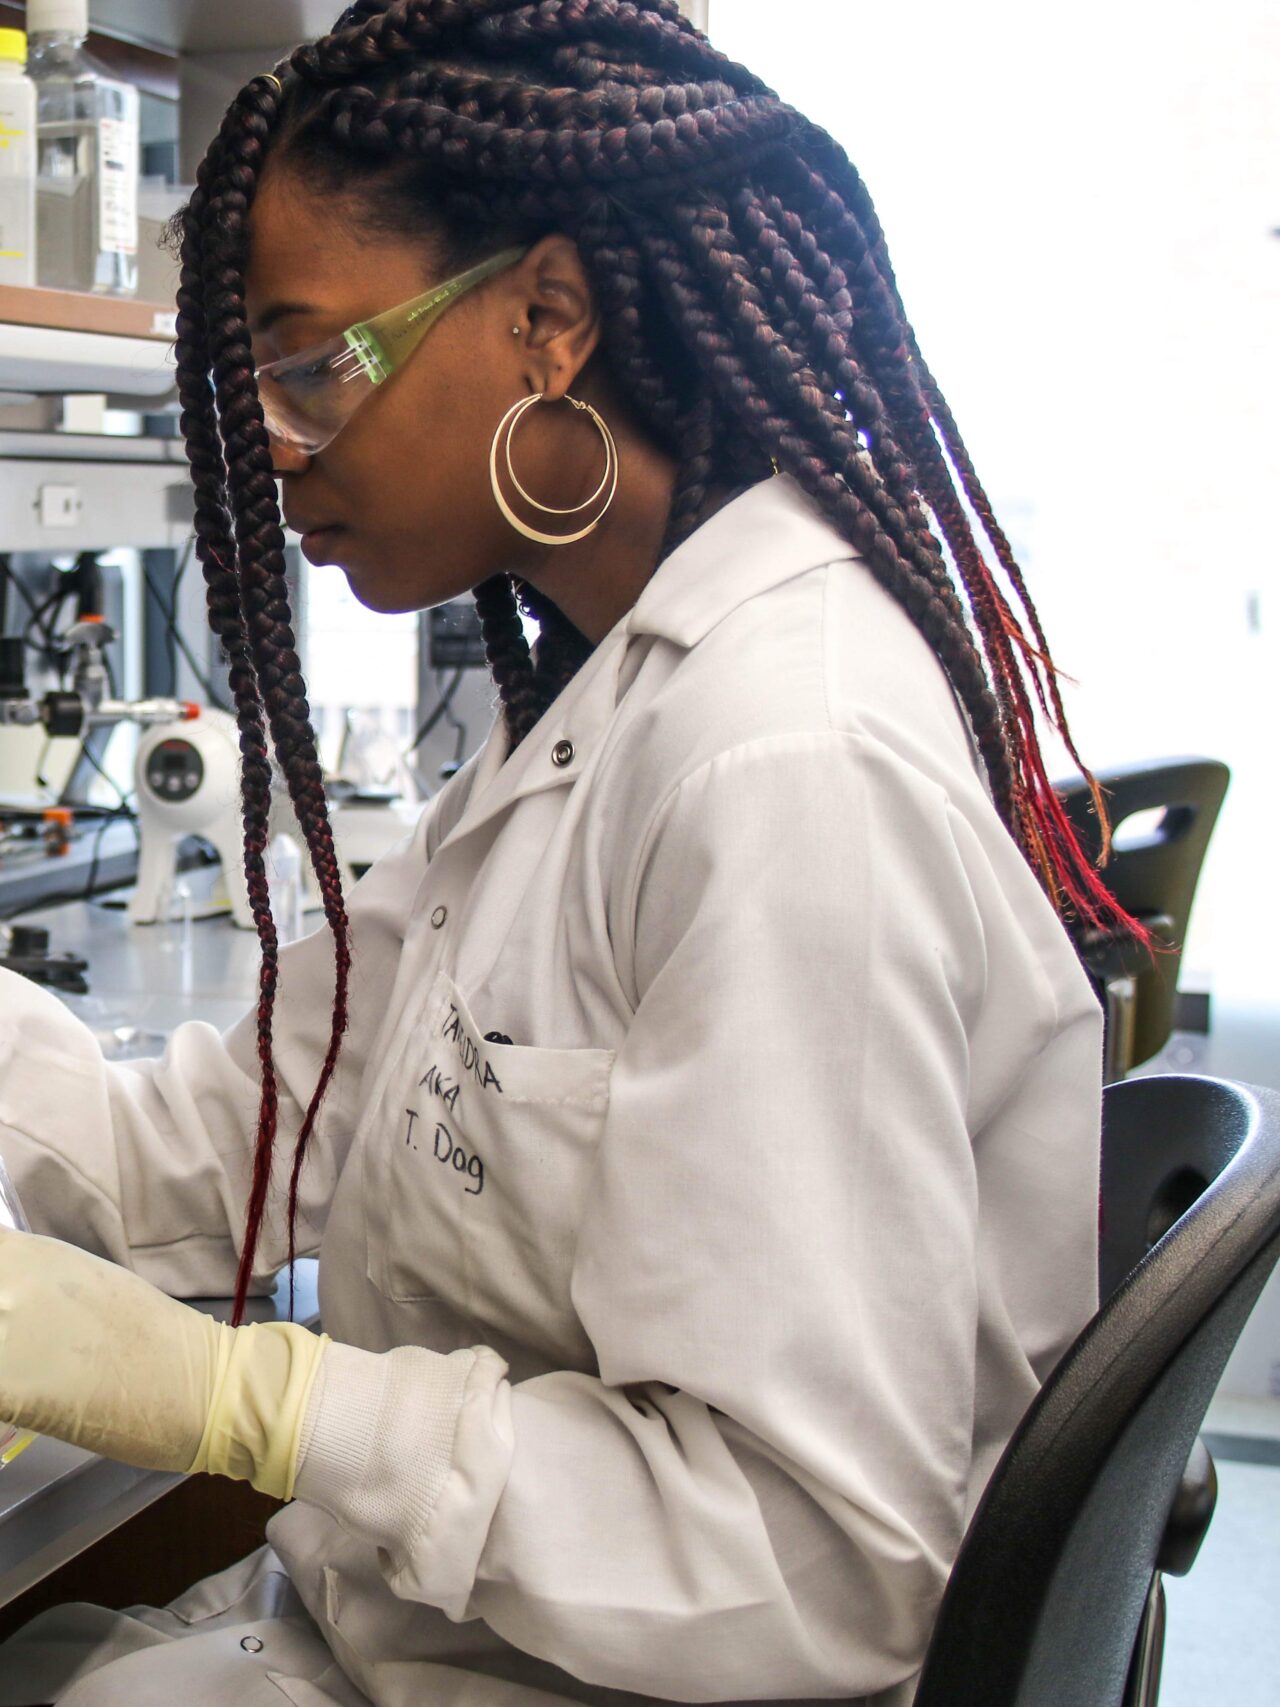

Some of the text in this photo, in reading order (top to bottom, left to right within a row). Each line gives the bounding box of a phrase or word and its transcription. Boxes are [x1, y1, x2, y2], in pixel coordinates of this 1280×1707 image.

[419, 1065, 461, 1113] AKA
[406, 1108, 484, 1196] T. Dog
